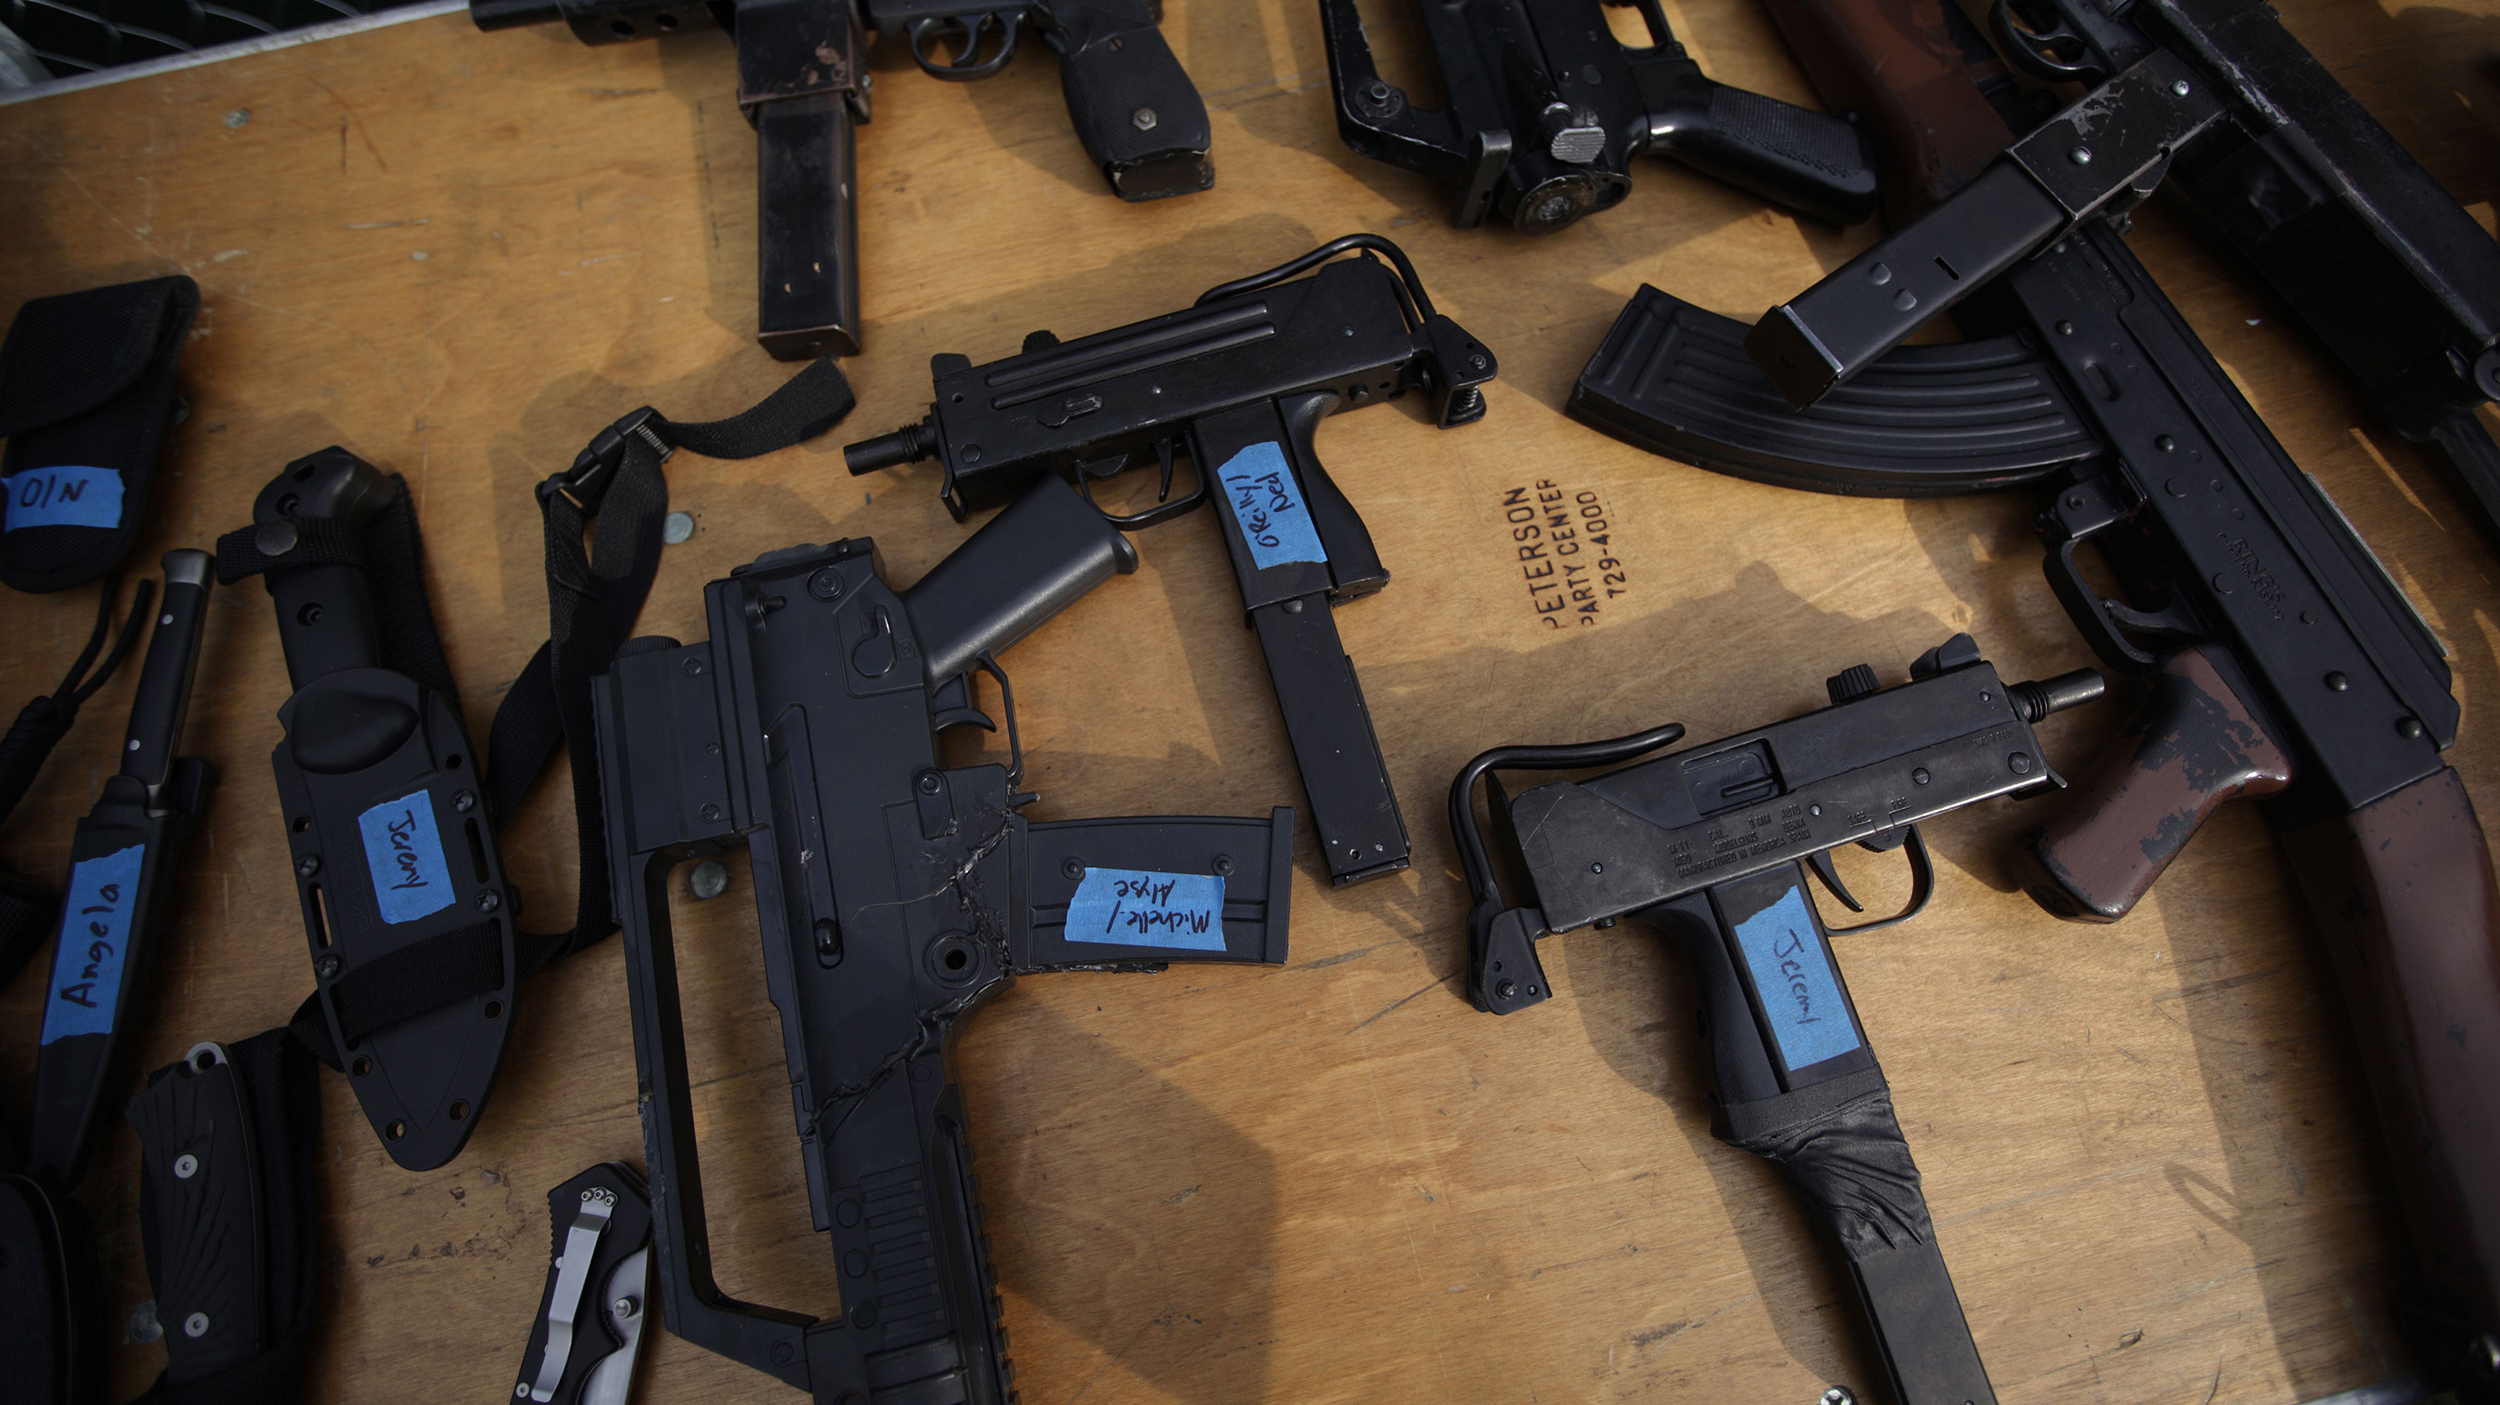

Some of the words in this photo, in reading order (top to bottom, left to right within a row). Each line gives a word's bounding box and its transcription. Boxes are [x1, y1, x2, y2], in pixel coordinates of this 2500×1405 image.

[1255, 471, 1295, 512] Ned
[1536, 479, 1580, 556] CENTER
[1503, 487, 1567, 629] PETERSON
[1576, 491, 1626, 599] 729-4000
[1563, 565, 1599, 626] PARTY
[388, 809, 428, 890] Jeremy
[1781, 805, 1801, 819] AUTO
[1114, 876, 1175, 907] Alyse
[1677, 852, 1737, 878] MANUFACTURED
[1787, 829, 1811, 844] SPAIN
[61, 884, 120, 1009] Angela
[1774, 929, 1821, 1025] Jeremy
